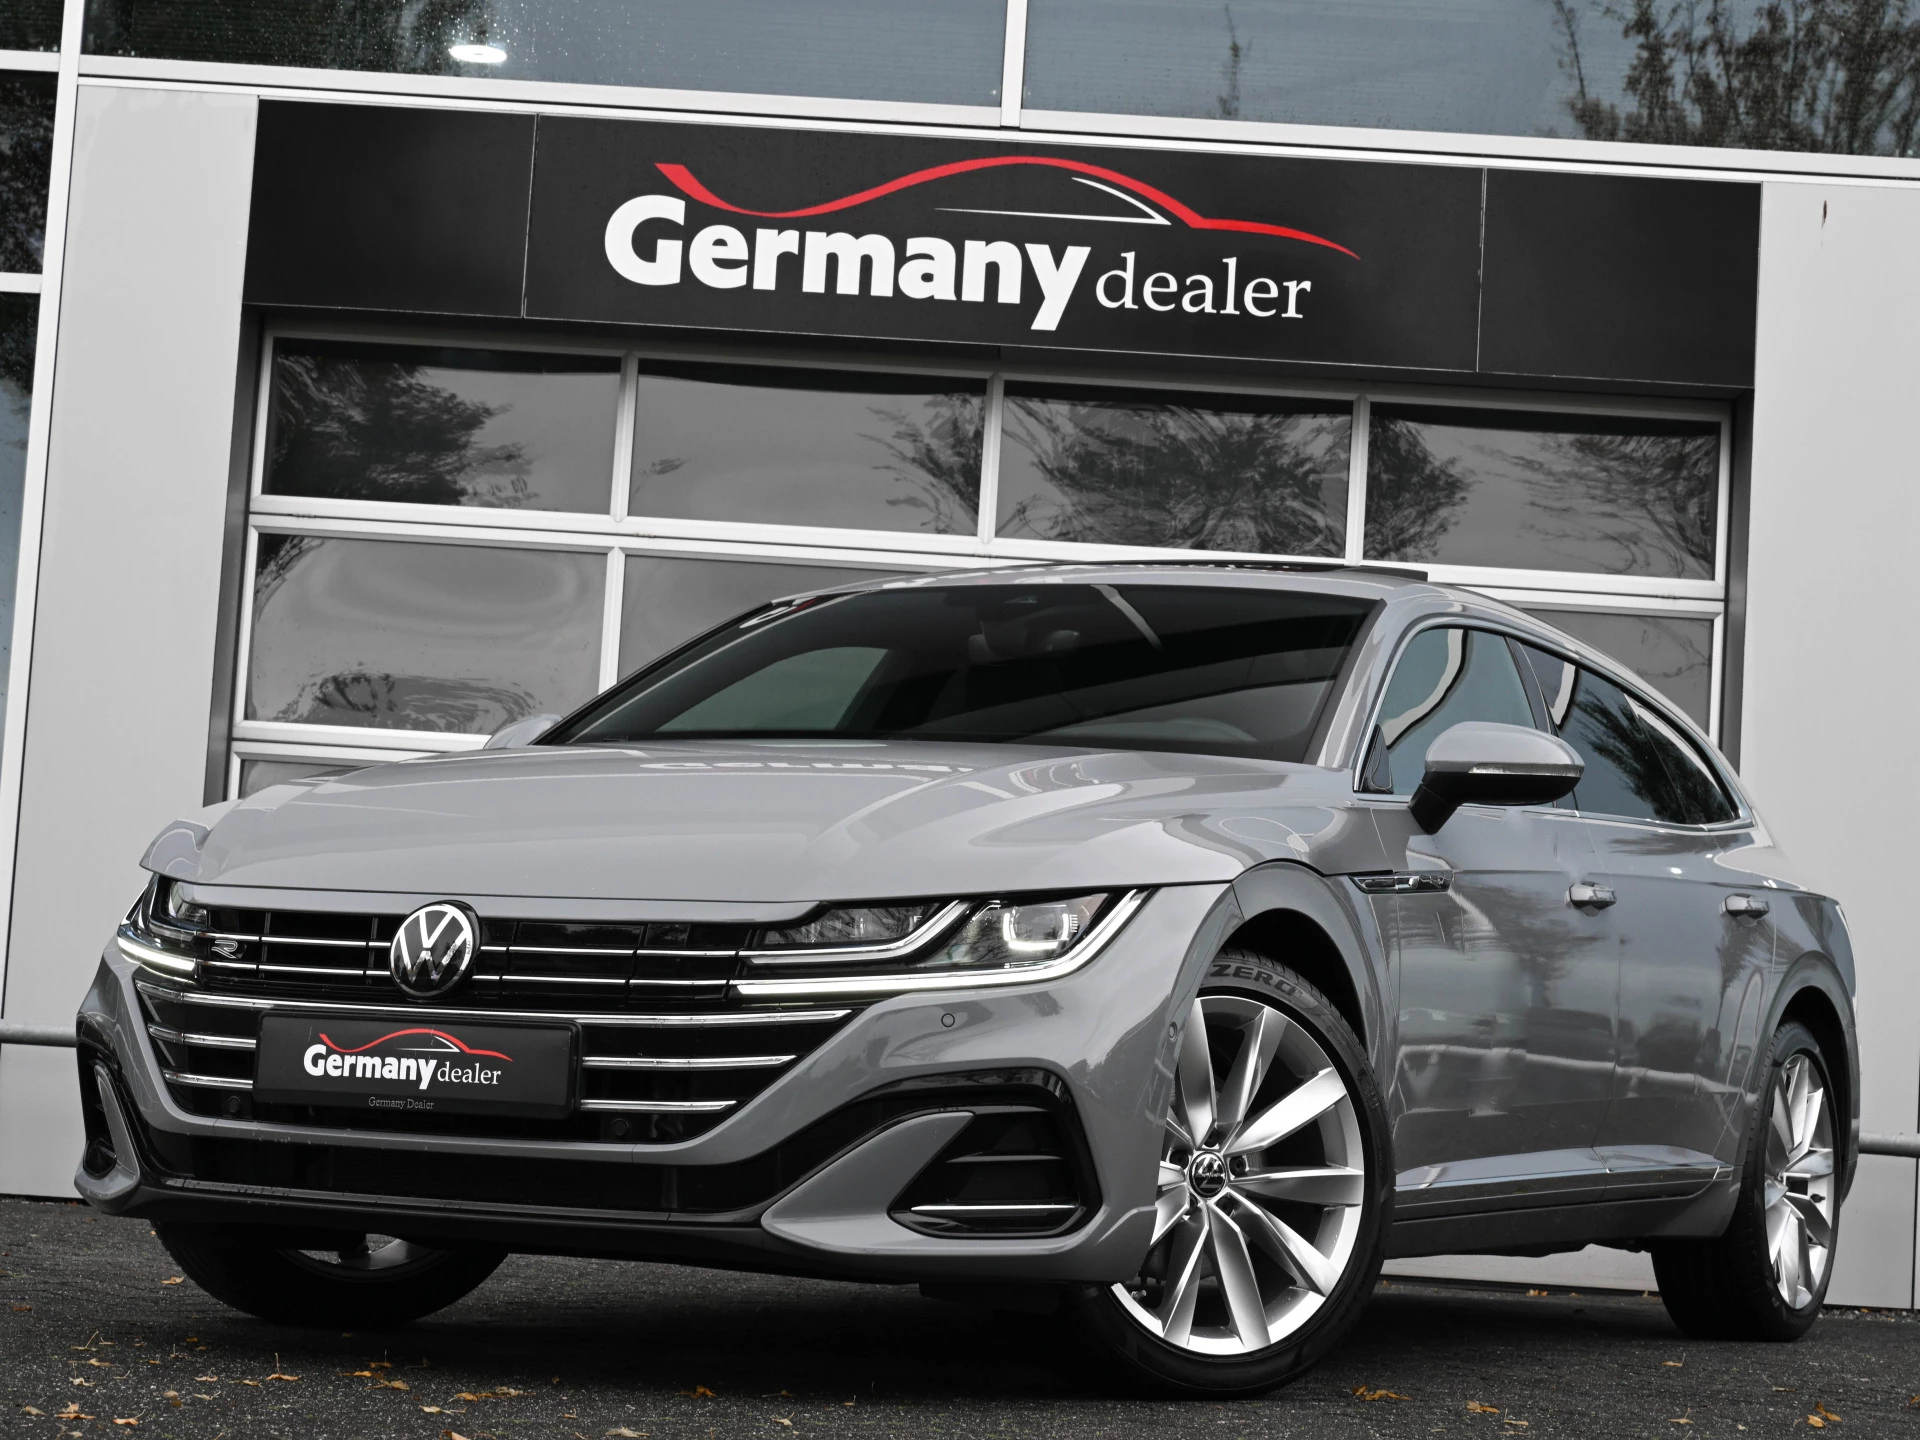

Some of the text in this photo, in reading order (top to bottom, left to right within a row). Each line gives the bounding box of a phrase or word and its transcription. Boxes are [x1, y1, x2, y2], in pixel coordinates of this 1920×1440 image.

[604, 194, 1312, 332] Germany dealer
[1210, 963, 1297, 996] ZERO
[303, 1043, 503, 1090] Germany dealer
[368, 1096, 435, 1110] Germany Dealer
